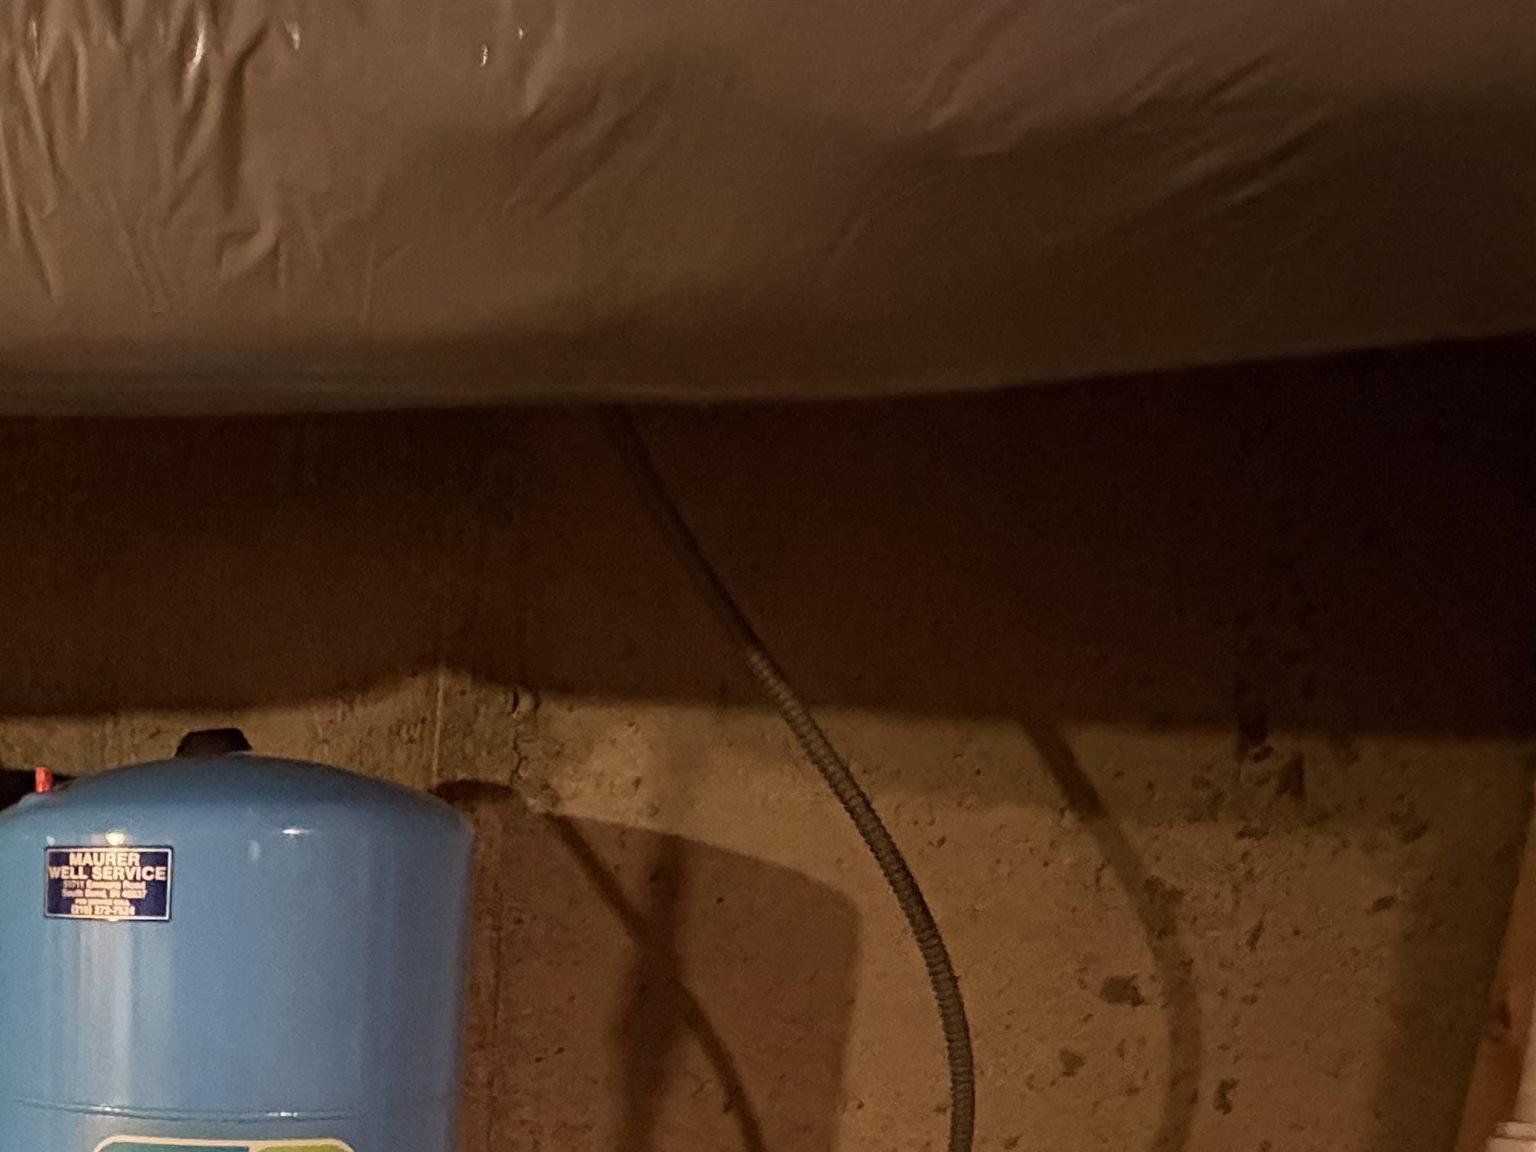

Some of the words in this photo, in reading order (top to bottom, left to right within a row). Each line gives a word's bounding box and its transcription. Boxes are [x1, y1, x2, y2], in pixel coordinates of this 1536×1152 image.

[69, 852, 140, 866] MAURER
[49, 866, 88, 880] WELL
[91, 866, 166, 881] SERVICE
